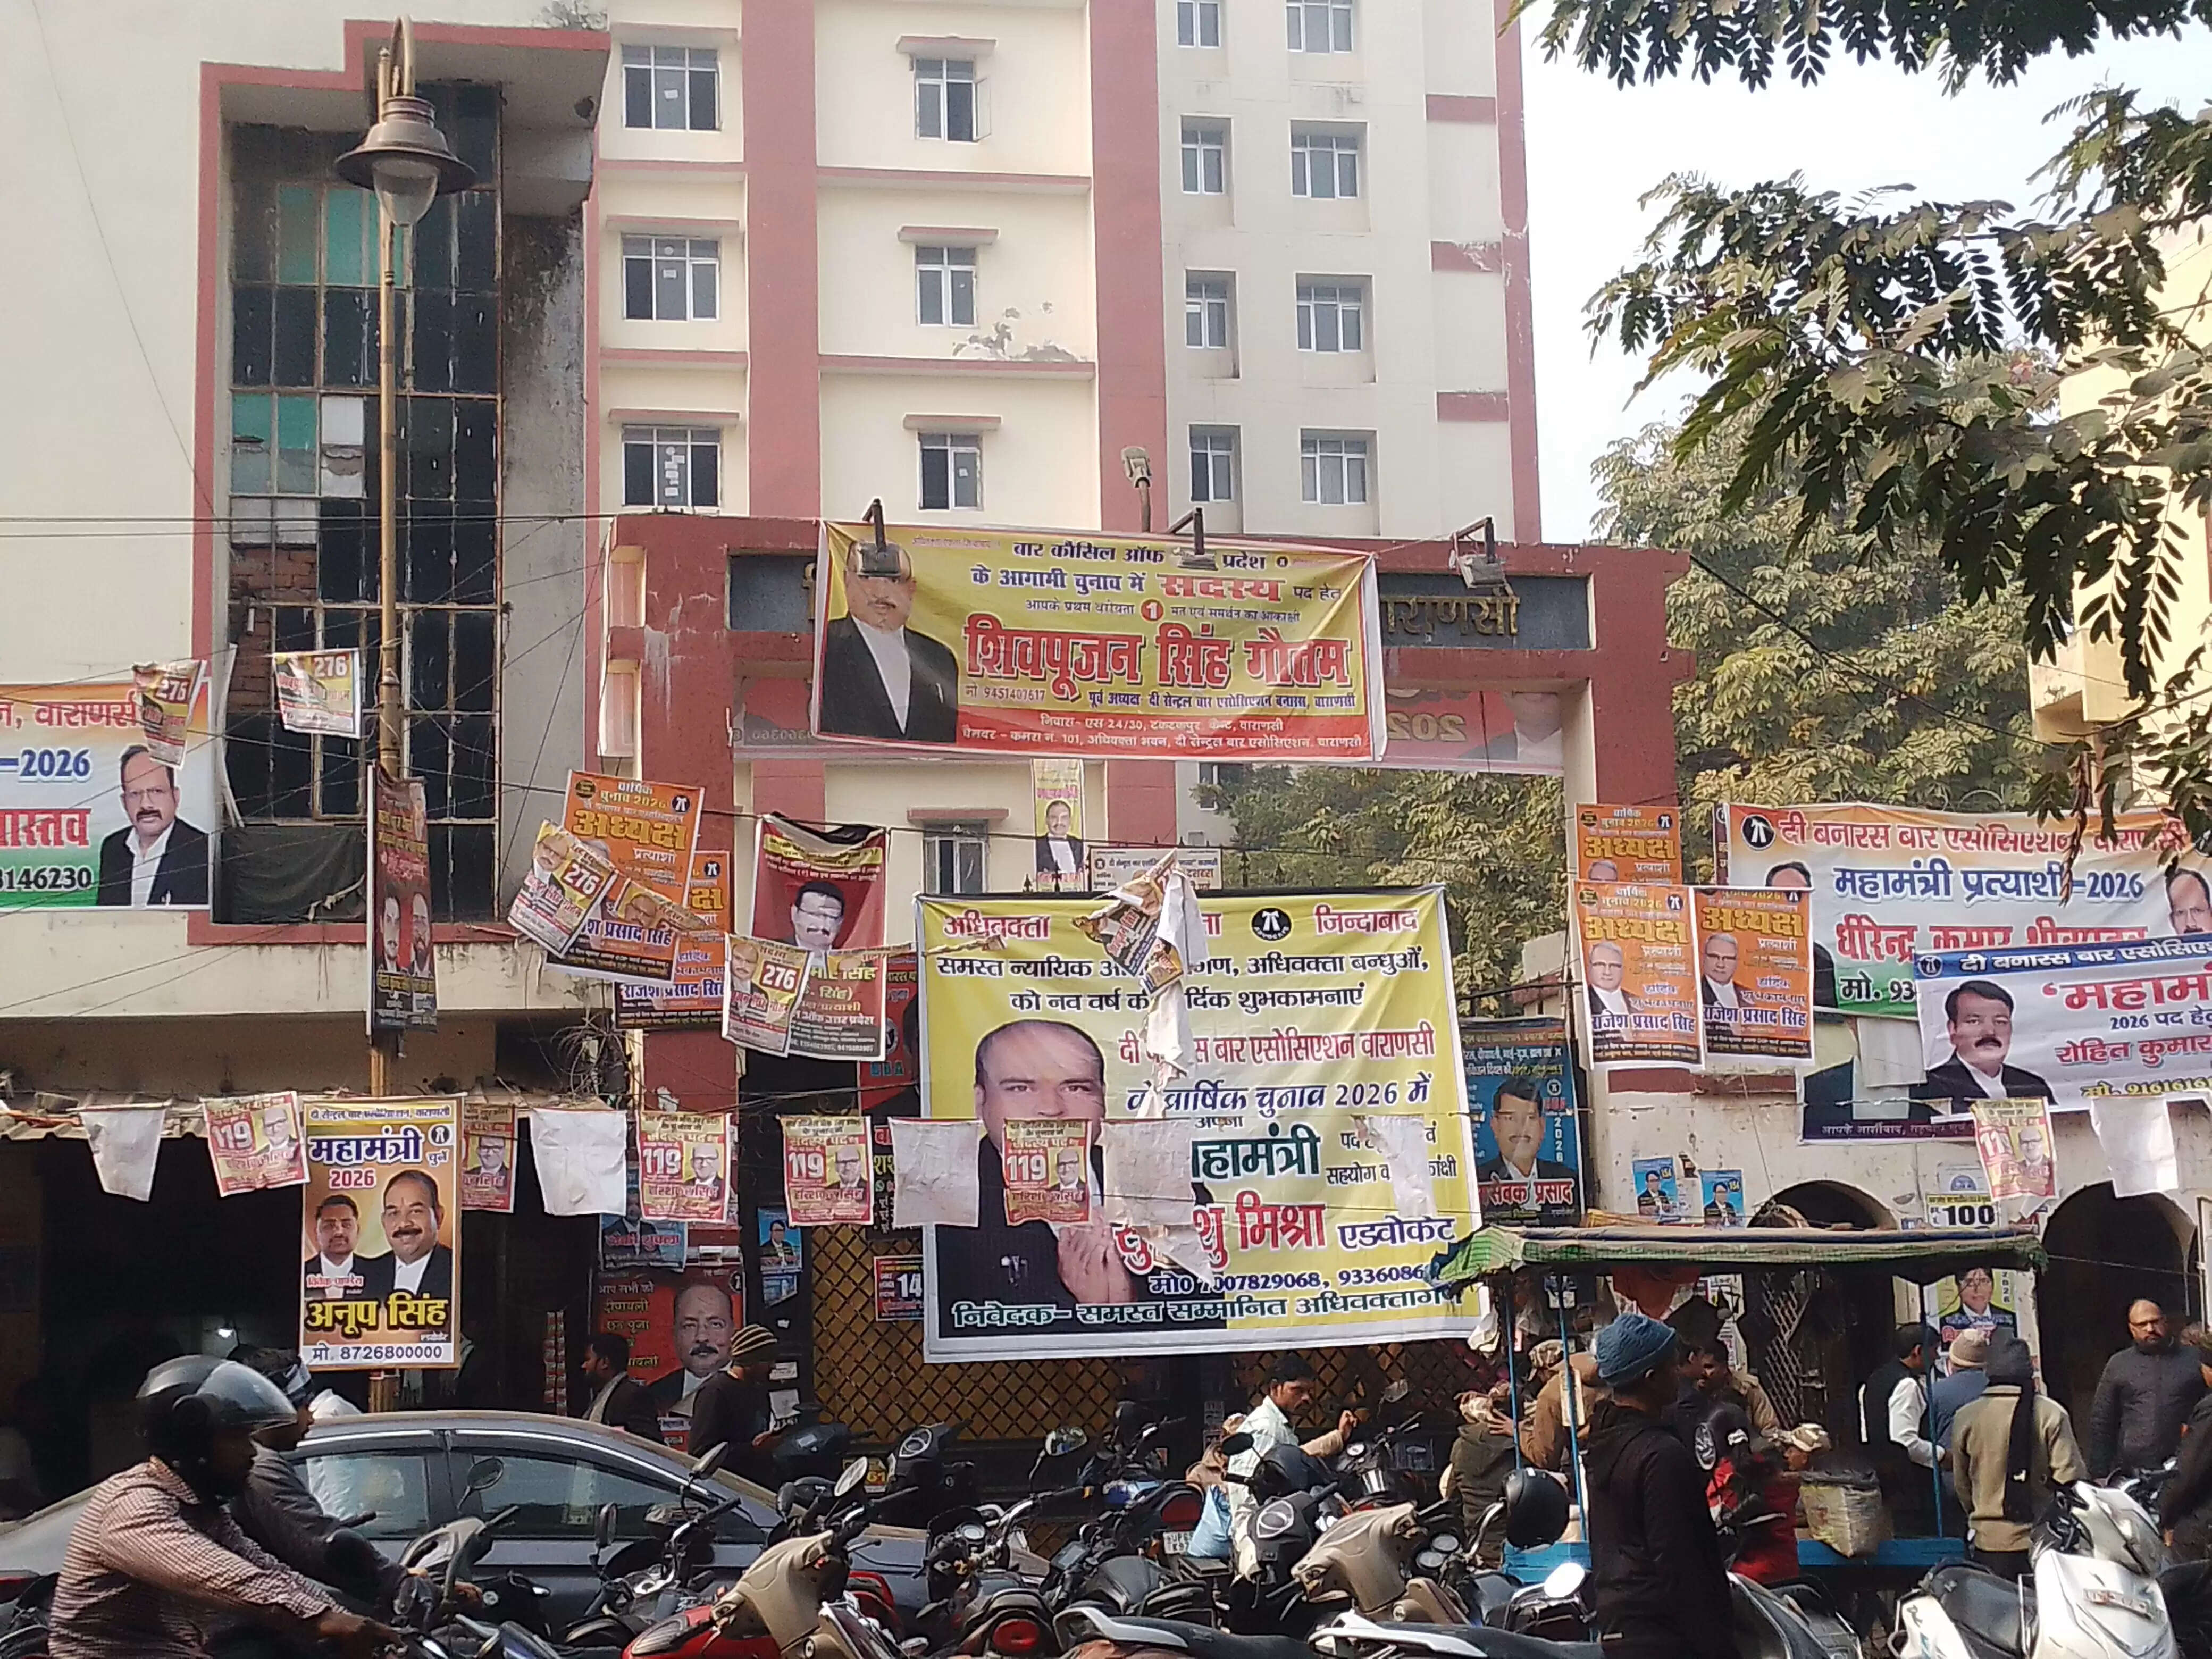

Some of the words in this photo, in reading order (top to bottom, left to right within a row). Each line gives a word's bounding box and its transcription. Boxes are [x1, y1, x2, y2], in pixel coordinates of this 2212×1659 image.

[1122, 546, 1165, 564] ऑफ
[1222, 551, 1267, 571] प्रदेश
[971, 564, 992, 584] के
[1000, 568, 1067, 588] आगामी
[1073, 574, 1123, 595] चुनाव
[1128, 573, 1147, 592] में
[1157, 573, 1286, 602] सदस्य
[1293, 585, 1313, 599] पद
[1026, 598, 1060, 612] आपके
[314, 656, 348, 678] 276
[963, 611, 1146, 702] शिवपूजन
[1156, 623, 1235, 689] सिंह
[1244, 627, 1352, 688] गौतम
[156, 678, 189, 701] 276
[1108, 718, 1146, 732] 24/30,
[1063, 733, 1084, 746] 101,
[572, 808, 688, 851] अध्यक्ष
[1778, 811, 1807, 847] दी
[1813, 822, 1891, 849] बनारस
[1896, 826, 1939, 849] बार
[1584, 836, 1678, 861] अध्यक्ष
[563, 862, 601, 896] 276
[1833, 857, 1954, 900] महामंत्री
[605, 920, 643, 942] प्रसाद
[1313, 904, 1419, 935] जिन्दाबाद
[1583, 916, 1690, 945] अध्यक्ष
[1701, 906, 1805, 938] अध्यक्ष
[1836, 913, 1918, 963] धीरेन्द्र
[937, 956, 1003, 977] समस्त
[1010, 956, 1094, 977] न्यायिक
[1247, 952, 1344, 975] अधिवक्ता
[1350, 946, 1429, 975] बन्धुओं,
[1960, 954, 1988, 971] दी
[1993, 951, 2072, 970] बनारस
[2077, 948, 2115, 963] बार
[761, 963, 798, 991] 276
[1839, 970, 1884, 1000] मो.
[1010, 988, 1041, 1010] को
[1046, 992, 1082, 1010] नव
[1088, 987, 1121, 1010] वर्ष
[1238, 982, 1365, 1013] शुभकामनाएं
[1631, 1013, 1668, 1032] प्रसाद
[1741, 1007, 1779, 1025] प्रसाद
[1781, 1004, 1807, 1026] सिंह
[2110, 1015, 2149, 1030] 2026
[2154, 1012, 2184, 1026] पद
[1118, 1029, 1141, 1065] दी
[1213, 1036, 1246, 1063] बार
[1250, 1026, 1356, 1063] एसोसिएशन
[1360, 1021, 1436, 1060] वाराणसी
[2055, 1037, 2131, 1065] रोहित
[1163, 1078, 1249, 1111] वार्षिक
[1255, 1084, 1328, 1118] चुनाव
[1335, 1082, 1398, 1107] 2026
[1406, 1071, 1433, 1104] में
[211, 1121, 253, 1149] 119
[309, 1126, 423, 1163] महामंत्री
[642, 1147, 682, 1175] 119
[1192, 1122, 1322, 1180] हामंत्री
[331, 1170, 375, 1188] 2026
[788, 1152, 824, 1179] 119
[1006, 1154, 1047, 1182] 119
[1326, 1162, 1377, 1186] सहयोग
[1534, 1178, 1575, 1205] प्रसाद
[1235, 1191, 1327, 1251] मिश्रा
[1336, 1215, 1457, 1249] एडवोकेट
[1942, 1205, 1995, 1226] 100
[307, 1299, 379, 1338] अनूप
[388, 1292, 449, 1327] सिंह
[1075, 1301, 1163, 1324] समस्त
[1167, 1296, 1289, 1322] सम्मानित
[340, 1346, 442, 1360] 8726800000
